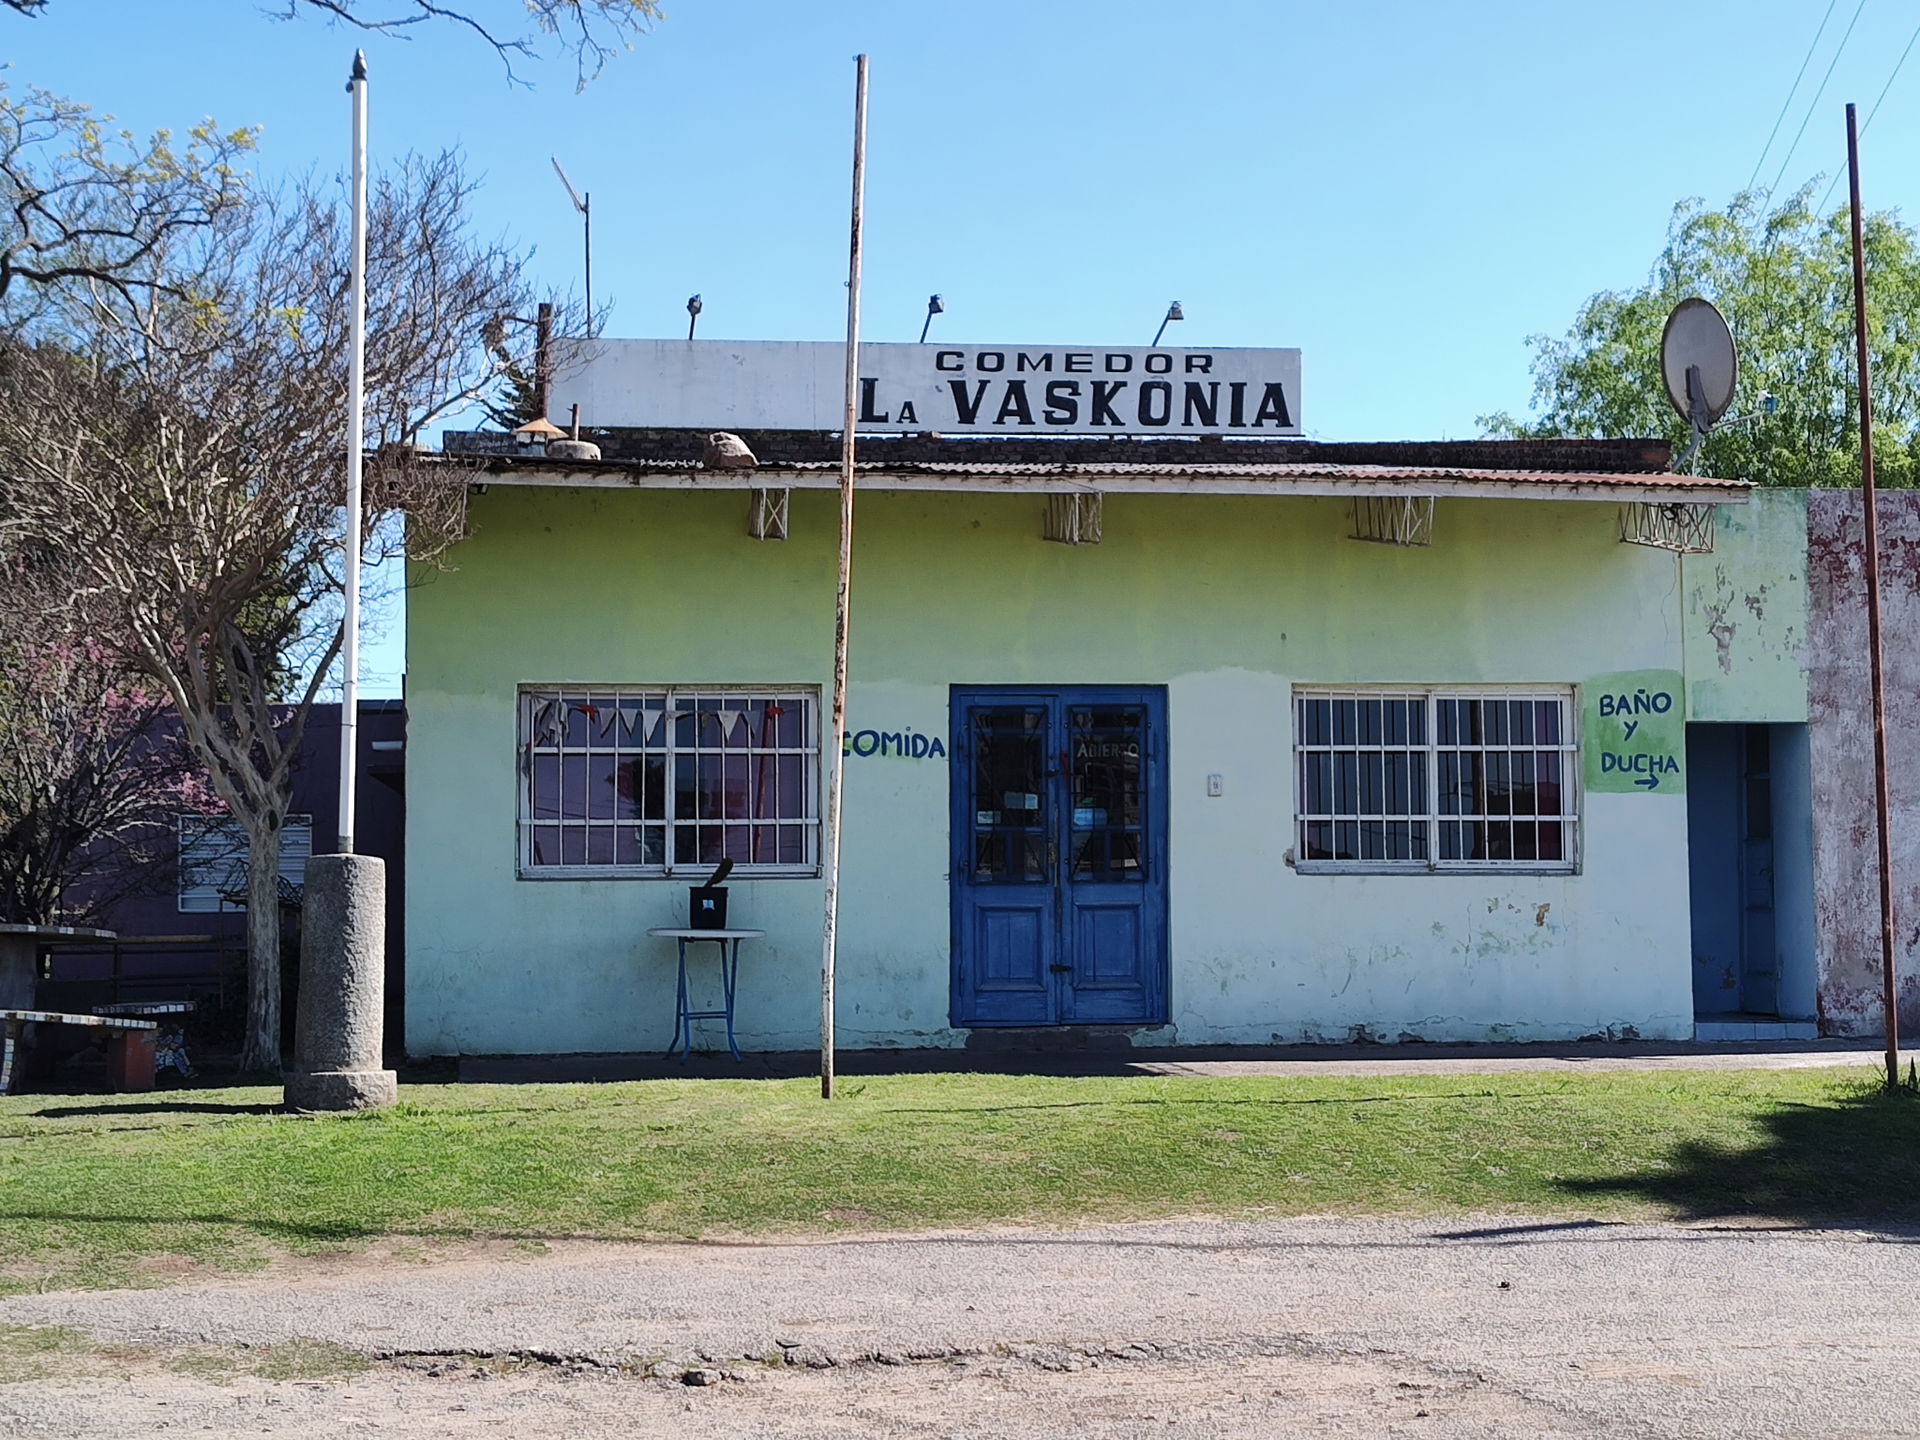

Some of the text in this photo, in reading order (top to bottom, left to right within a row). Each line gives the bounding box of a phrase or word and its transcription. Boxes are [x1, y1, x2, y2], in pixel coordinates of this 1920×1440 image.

[935, 351, 1215, 374] COMEDOR
[857, 377, 1295, 427] LA VASKONIA
[1599, 688, 1672, 717] BAÑO
[1623, 720, 1639, 742] Y
[1076, 743, 1140, 758] ABIERO
[1600, 752, 1680, 774] DUCHA
